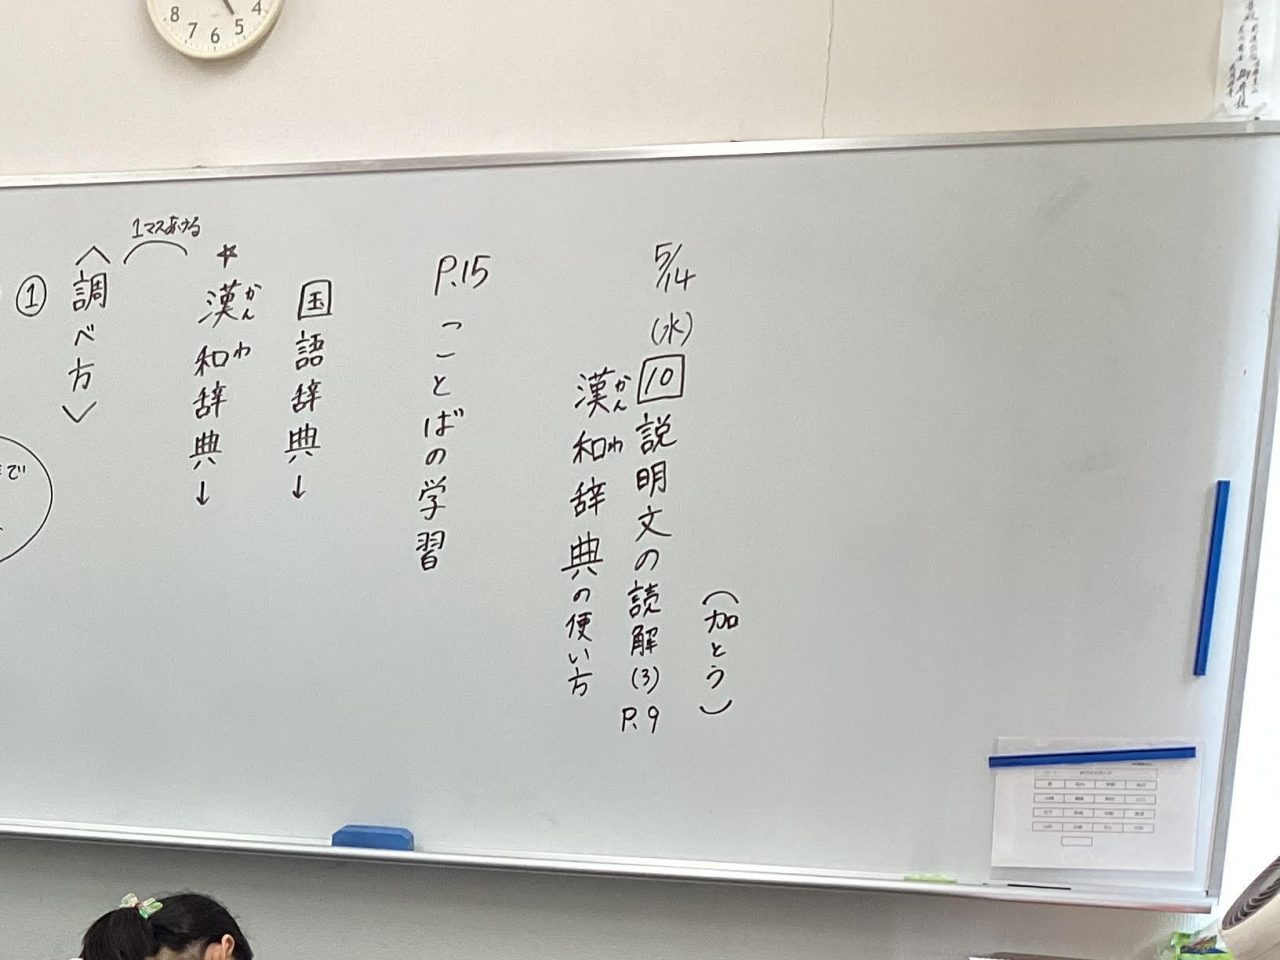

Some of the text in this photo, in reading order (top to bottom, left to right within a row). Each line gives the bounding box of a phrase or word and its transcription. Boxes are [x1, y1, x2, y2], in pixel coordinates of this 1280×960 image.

[170, 6, 180, 22] 8
[252, 0, 262, 15] 4
[188, 22, 198, 39] 7
[210, 27, 220, 44] 6
[235, 18, 244, 35] 5
[434, 255, 491, 297] P.15
[651, 312, 693, 347] (水)
[189, 279, 240, 470] 漢和辞典
[284, 279, 333, 464] 国語辞典
[561, 366, 612, 698] 漢和辞典の使い方
